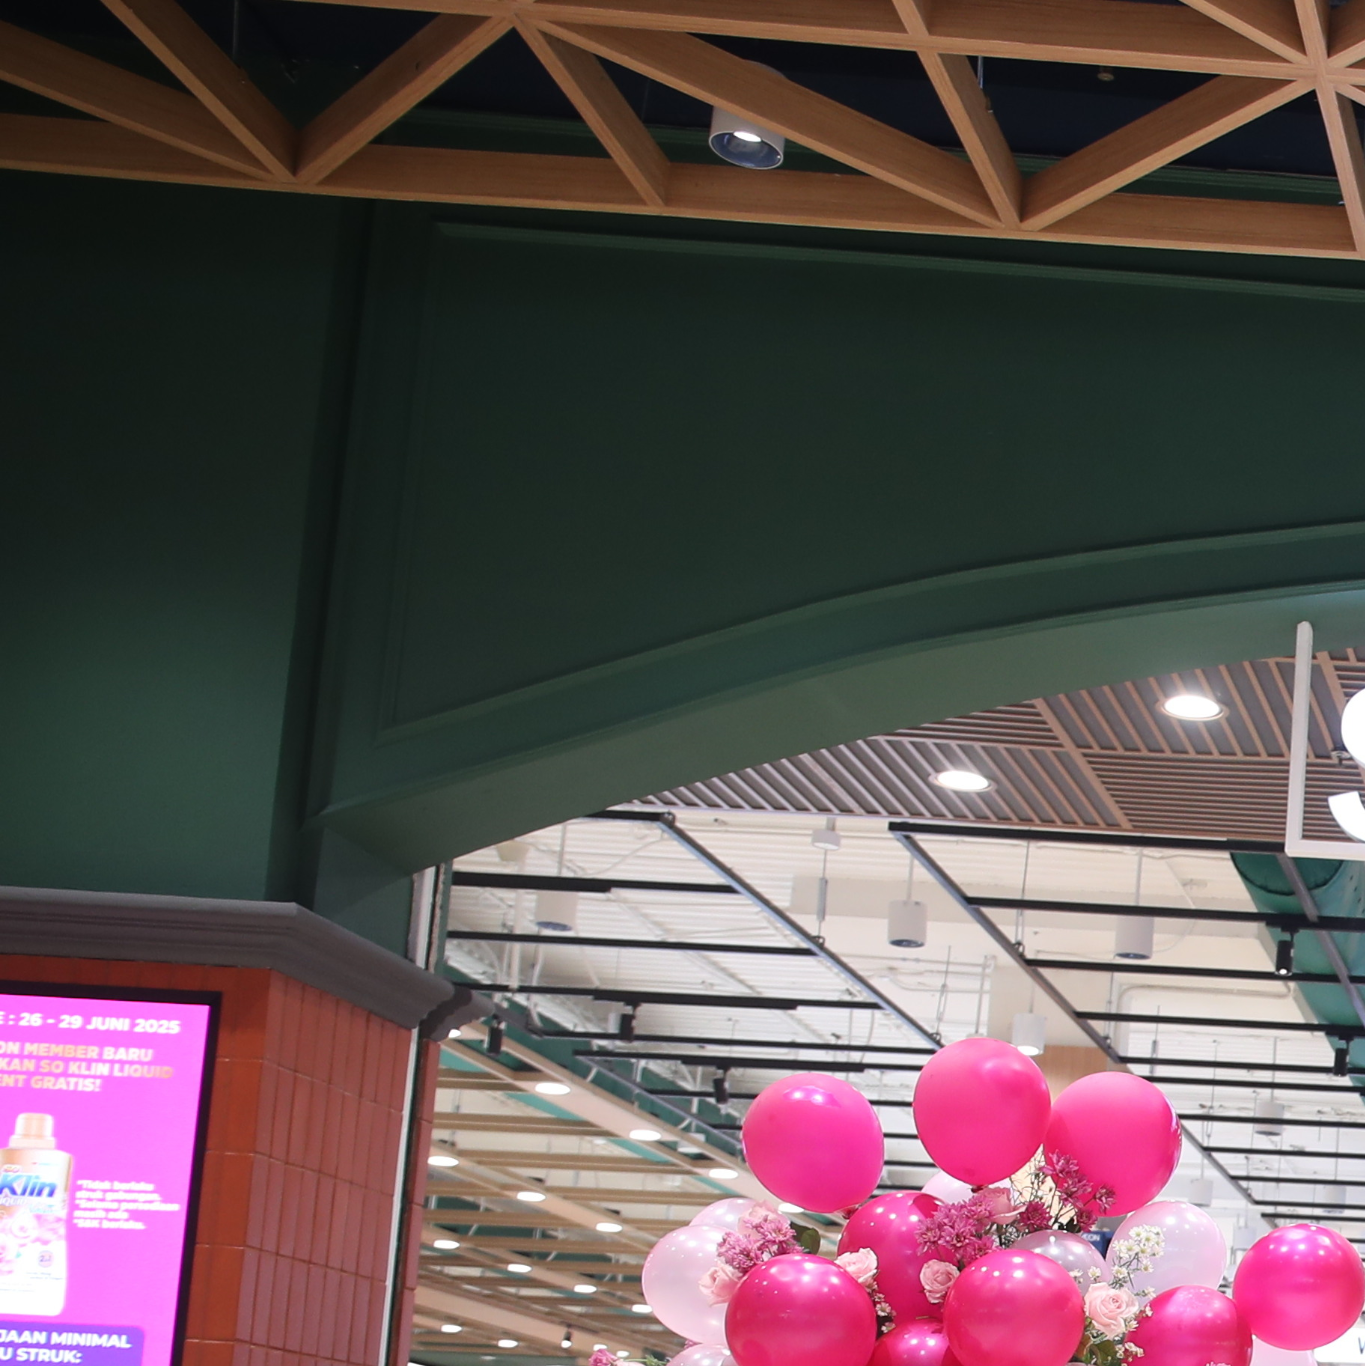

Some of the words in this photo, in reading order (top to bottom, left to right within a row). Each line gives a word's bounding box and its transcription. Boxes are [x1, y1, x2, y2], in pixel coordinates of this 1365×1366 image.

[18, 1012, 43, 1026] 26
[58, 1014, 82, 1029] 29
[86, 1016, 130, 1031] JUNI
[133, 1019, 181, 1034] 2025
[24, 1042, 99, 1059] MEMBER
[103, 1046, 153, 1062] BARU
[39, 1059, 64, 1073] SO
[68, 1061, 110, 1076] KLIN
[113, 1064, 173, 1079] LIQUID
[0, 1073, 27, 1087] NT
[31, 1075, 102, 1092] GRATIS!
[50, 1331, 132, 1348] MINIMAL
[16, 1347, 83, 1364] STRUK:
